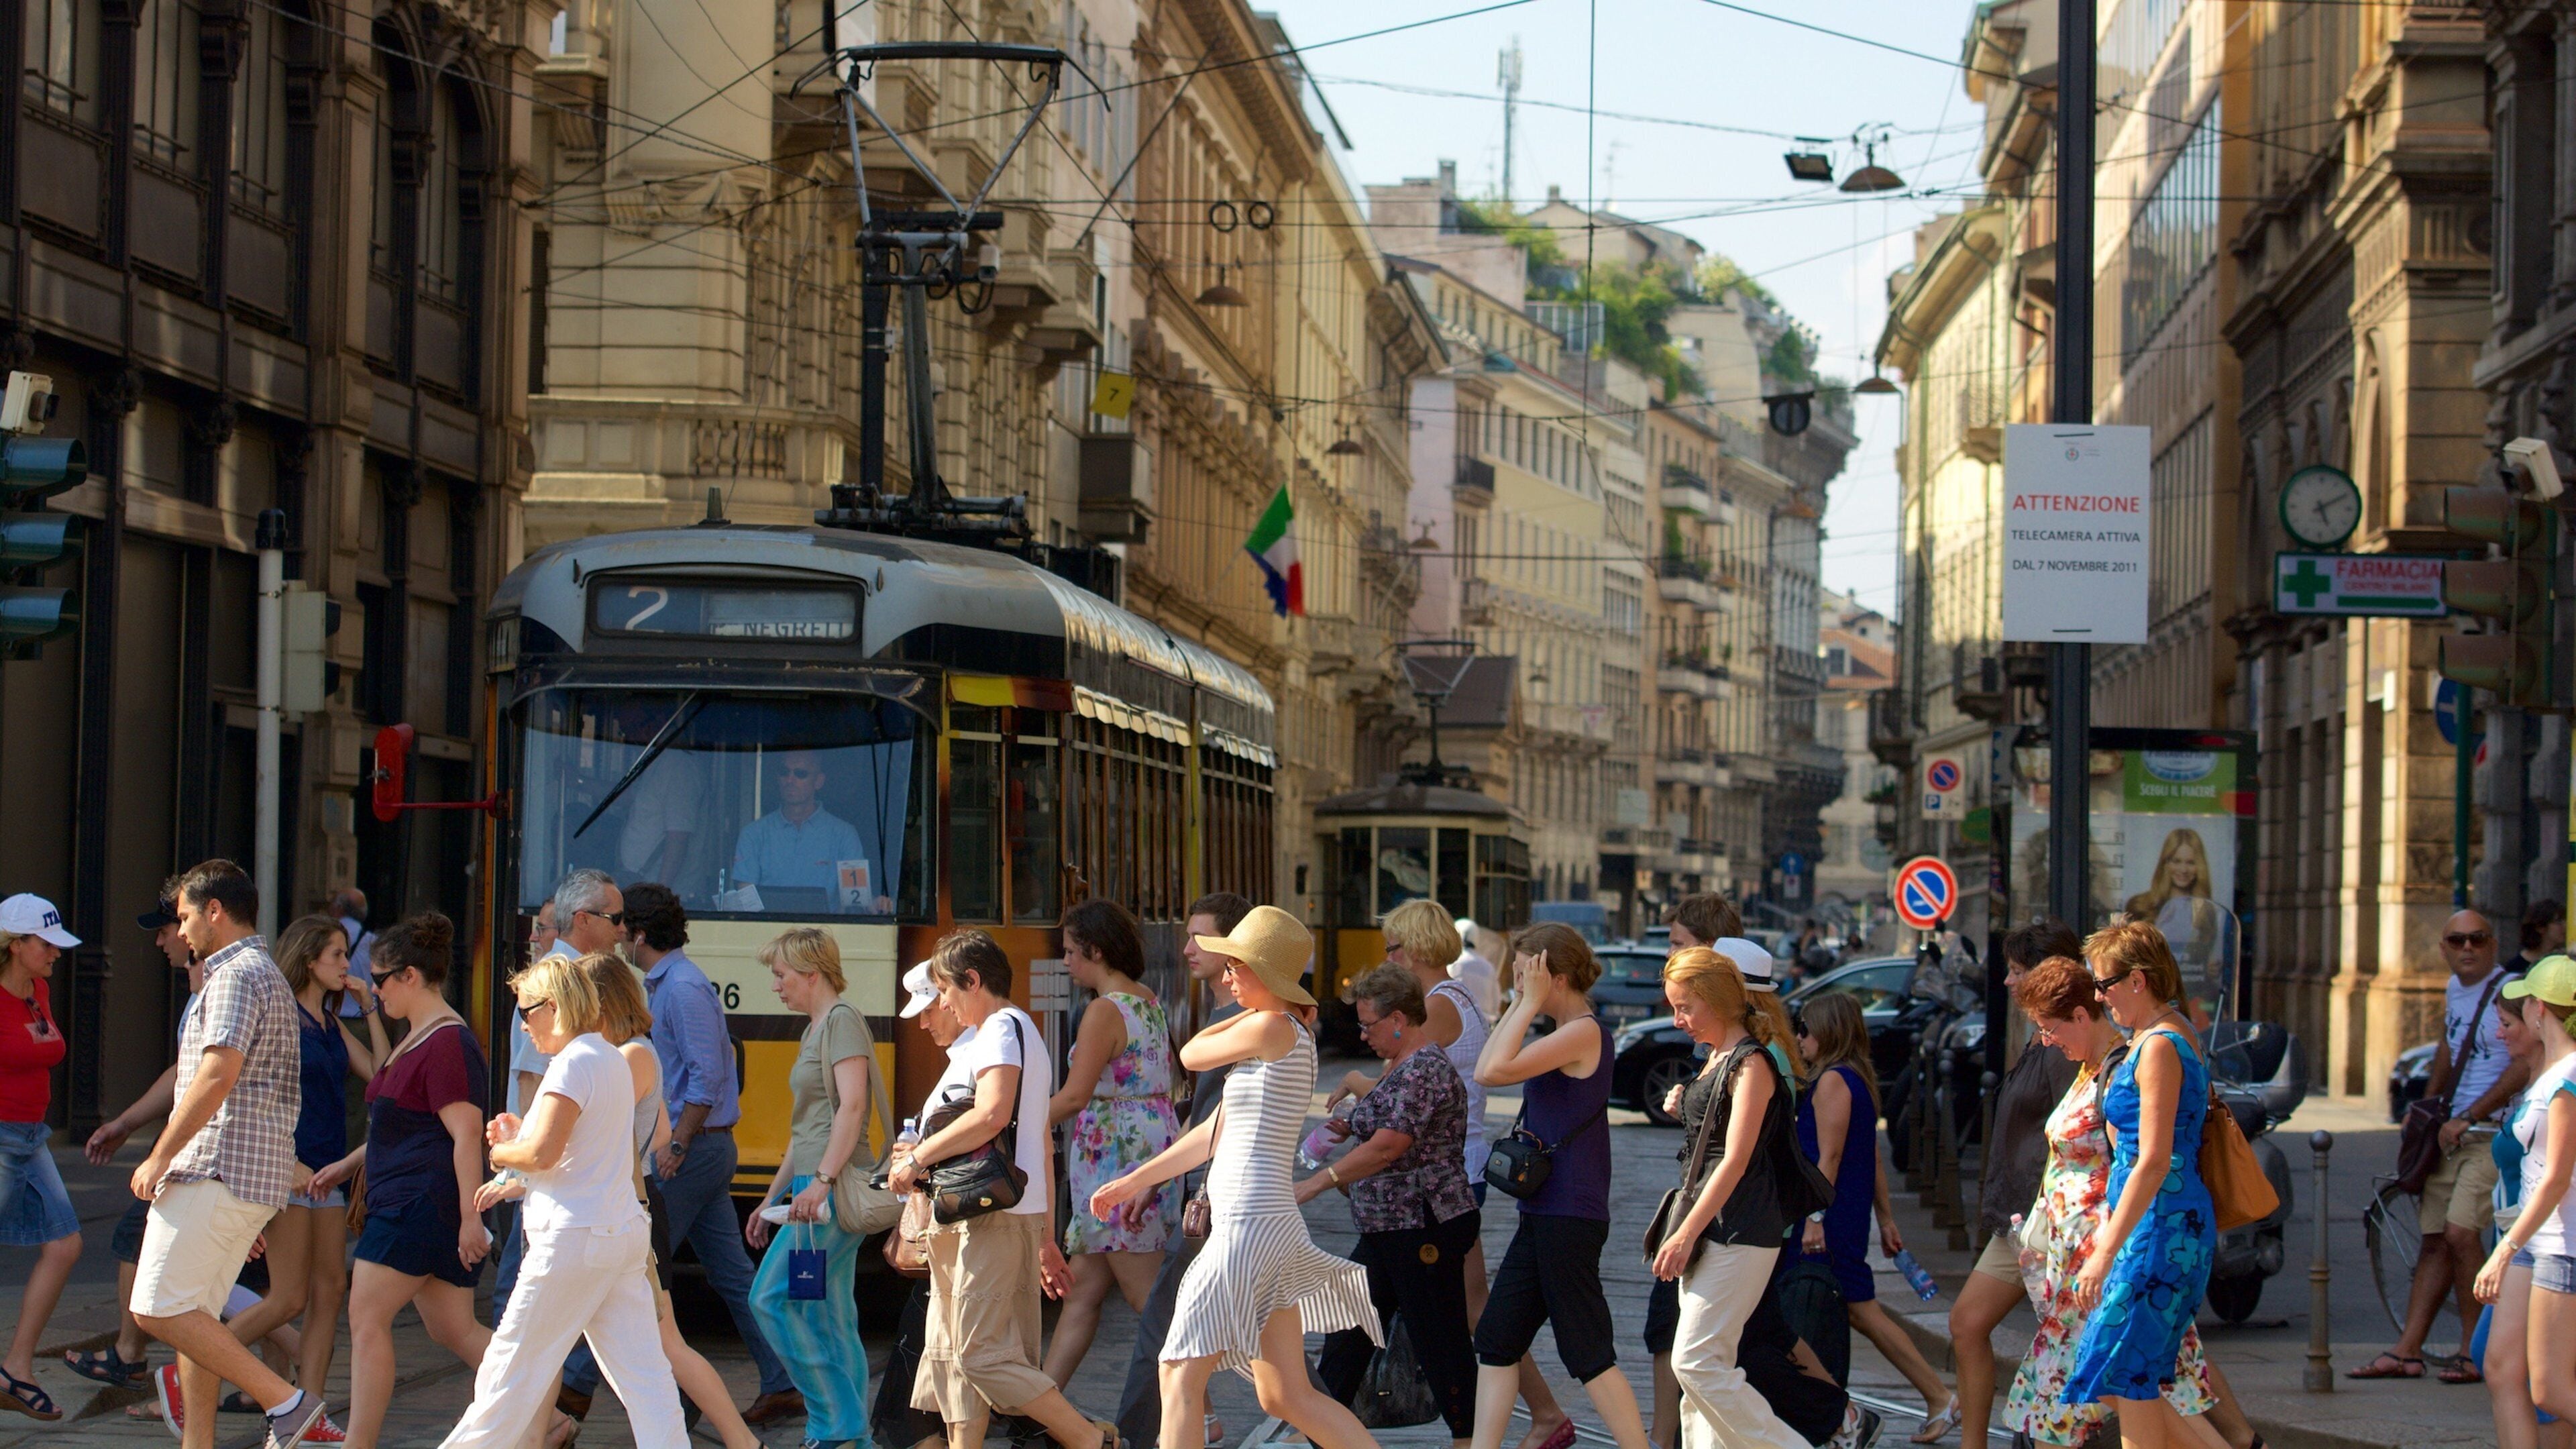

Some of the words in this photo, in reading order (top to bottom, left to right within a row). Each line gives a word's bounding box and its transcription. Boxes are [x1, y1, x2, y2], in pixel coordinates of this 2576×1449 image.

[1109, 388, 1119, 401] 7
[2012, 494, 2140, 513] ATTENZIONE
[2011, 530, 2093, 541] TELECAMERA
[2097, 532, 2141, 543] ATTIVA
[2012, 560, 2035, 570] DAL
[2038, 561, 2045, 570] 7
[2047, 561, 2109, 572] NOVEMBRE
[2112, 562, 2138, 572] 2011
[2335, 559, 2441, 580] FARMACIA
[625, 585, 669, 633] 2
[849, 870, 857, 886] 1
[851, 890, 861, 904] 2
